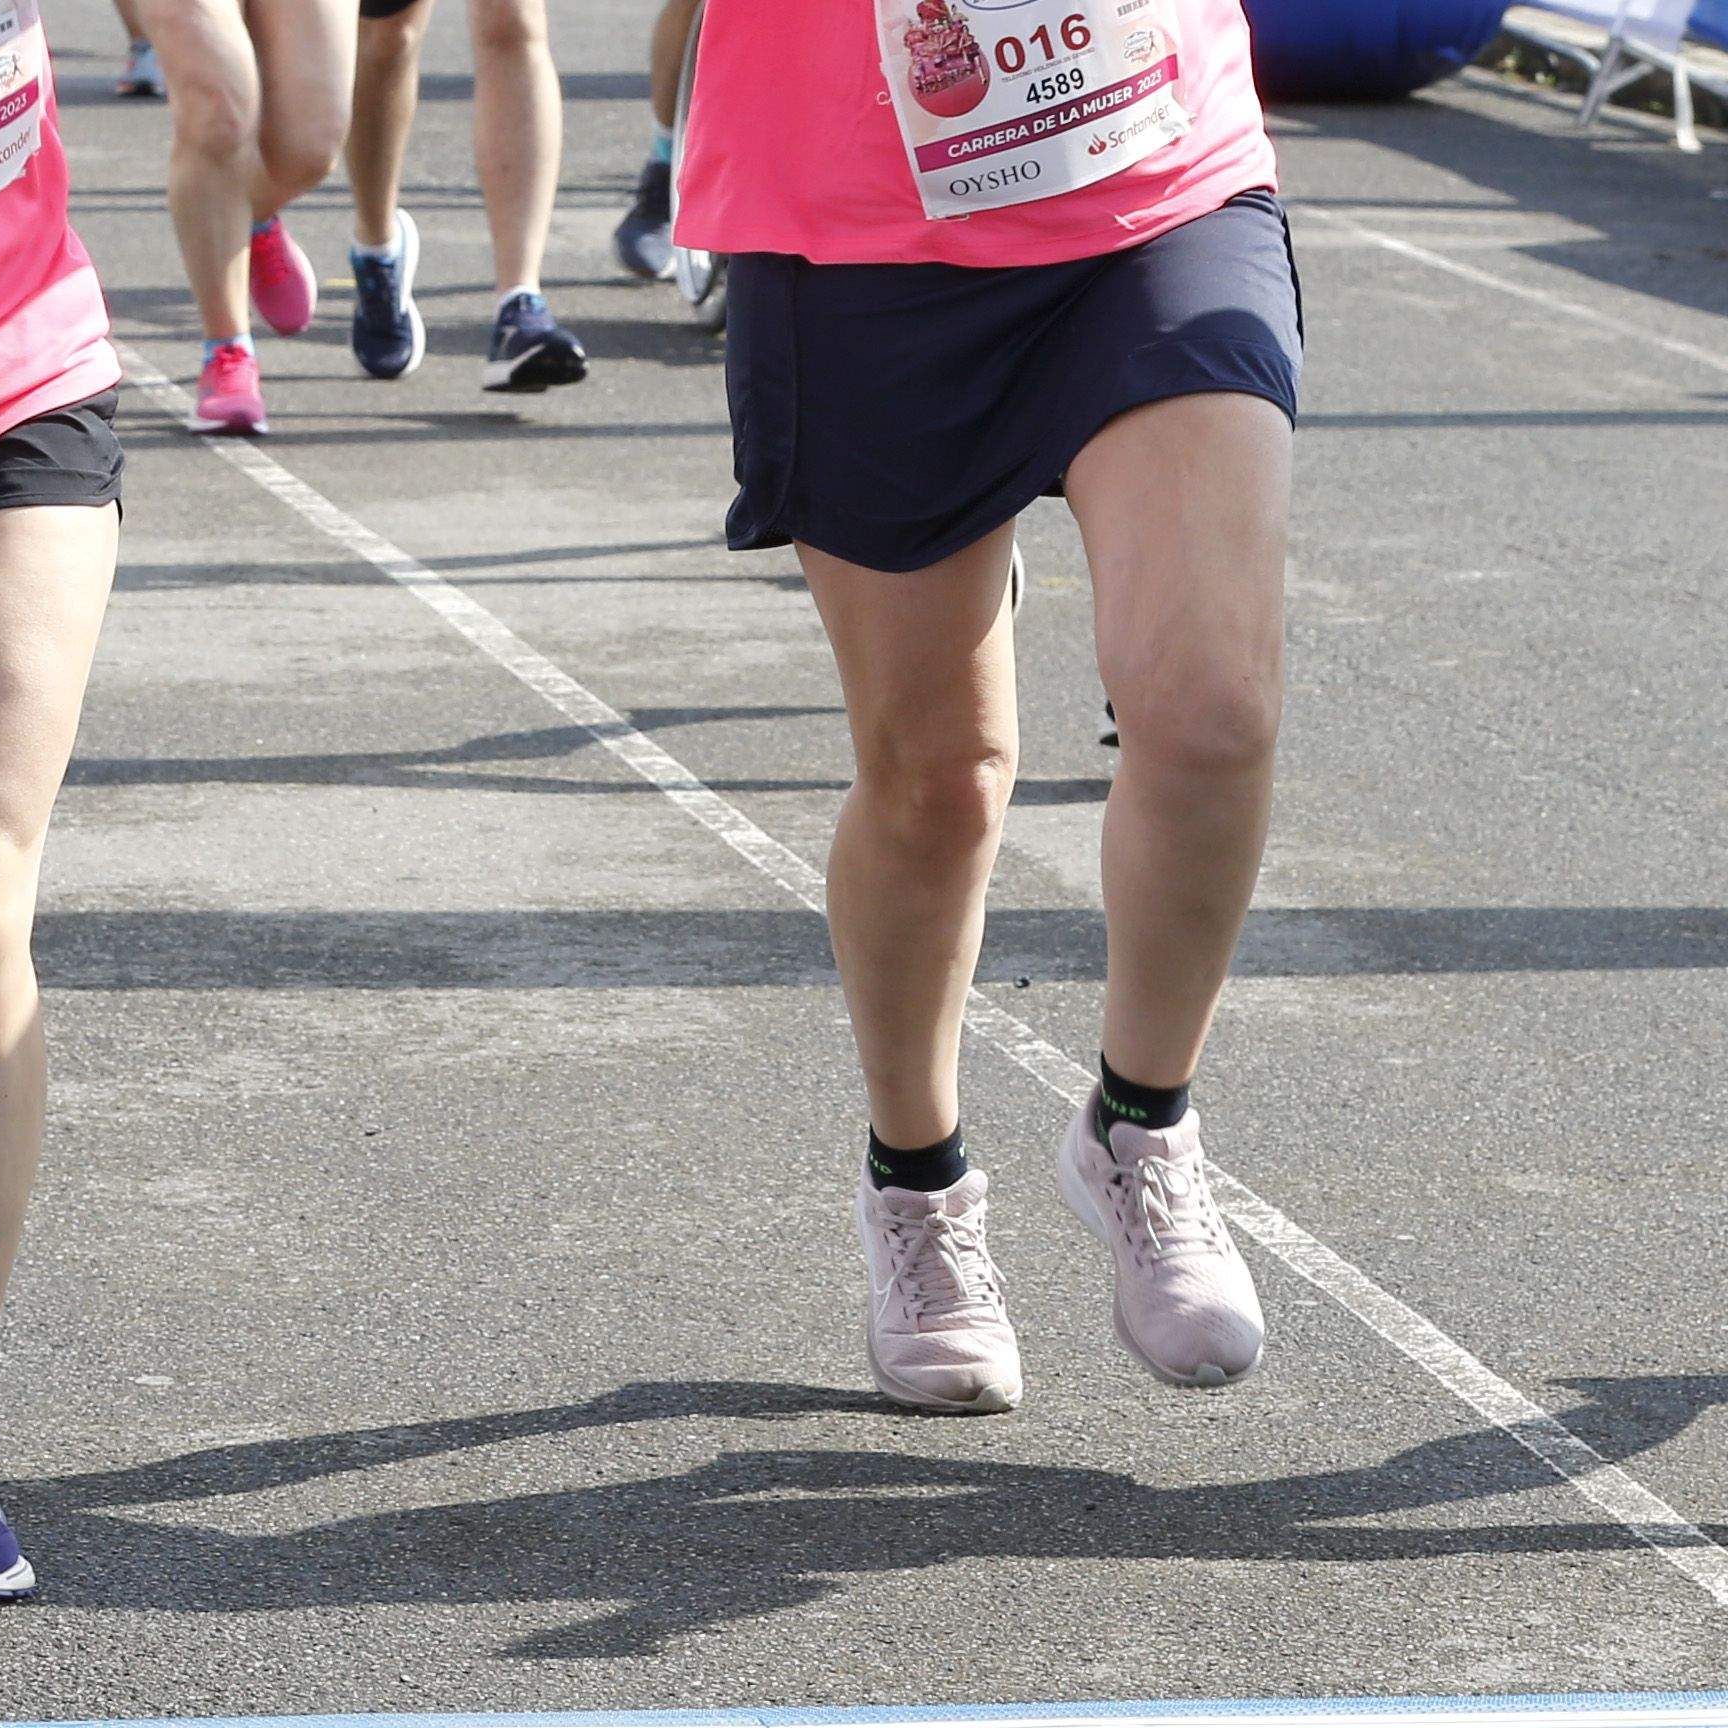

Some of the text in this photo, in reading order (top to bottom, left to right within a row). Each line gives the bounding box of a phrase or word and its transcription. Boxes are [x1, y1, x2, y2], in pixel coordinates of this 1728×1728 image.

[993, 12, 1093, 75] 016
[1025, 67, 1086, 105] 4589
[947, 70, 1164, 159] CARRERA DE LA MUJER 2023
[1107, 101, 1172, 151] Santander
[948, 158, 1043, 198] OYSHO
